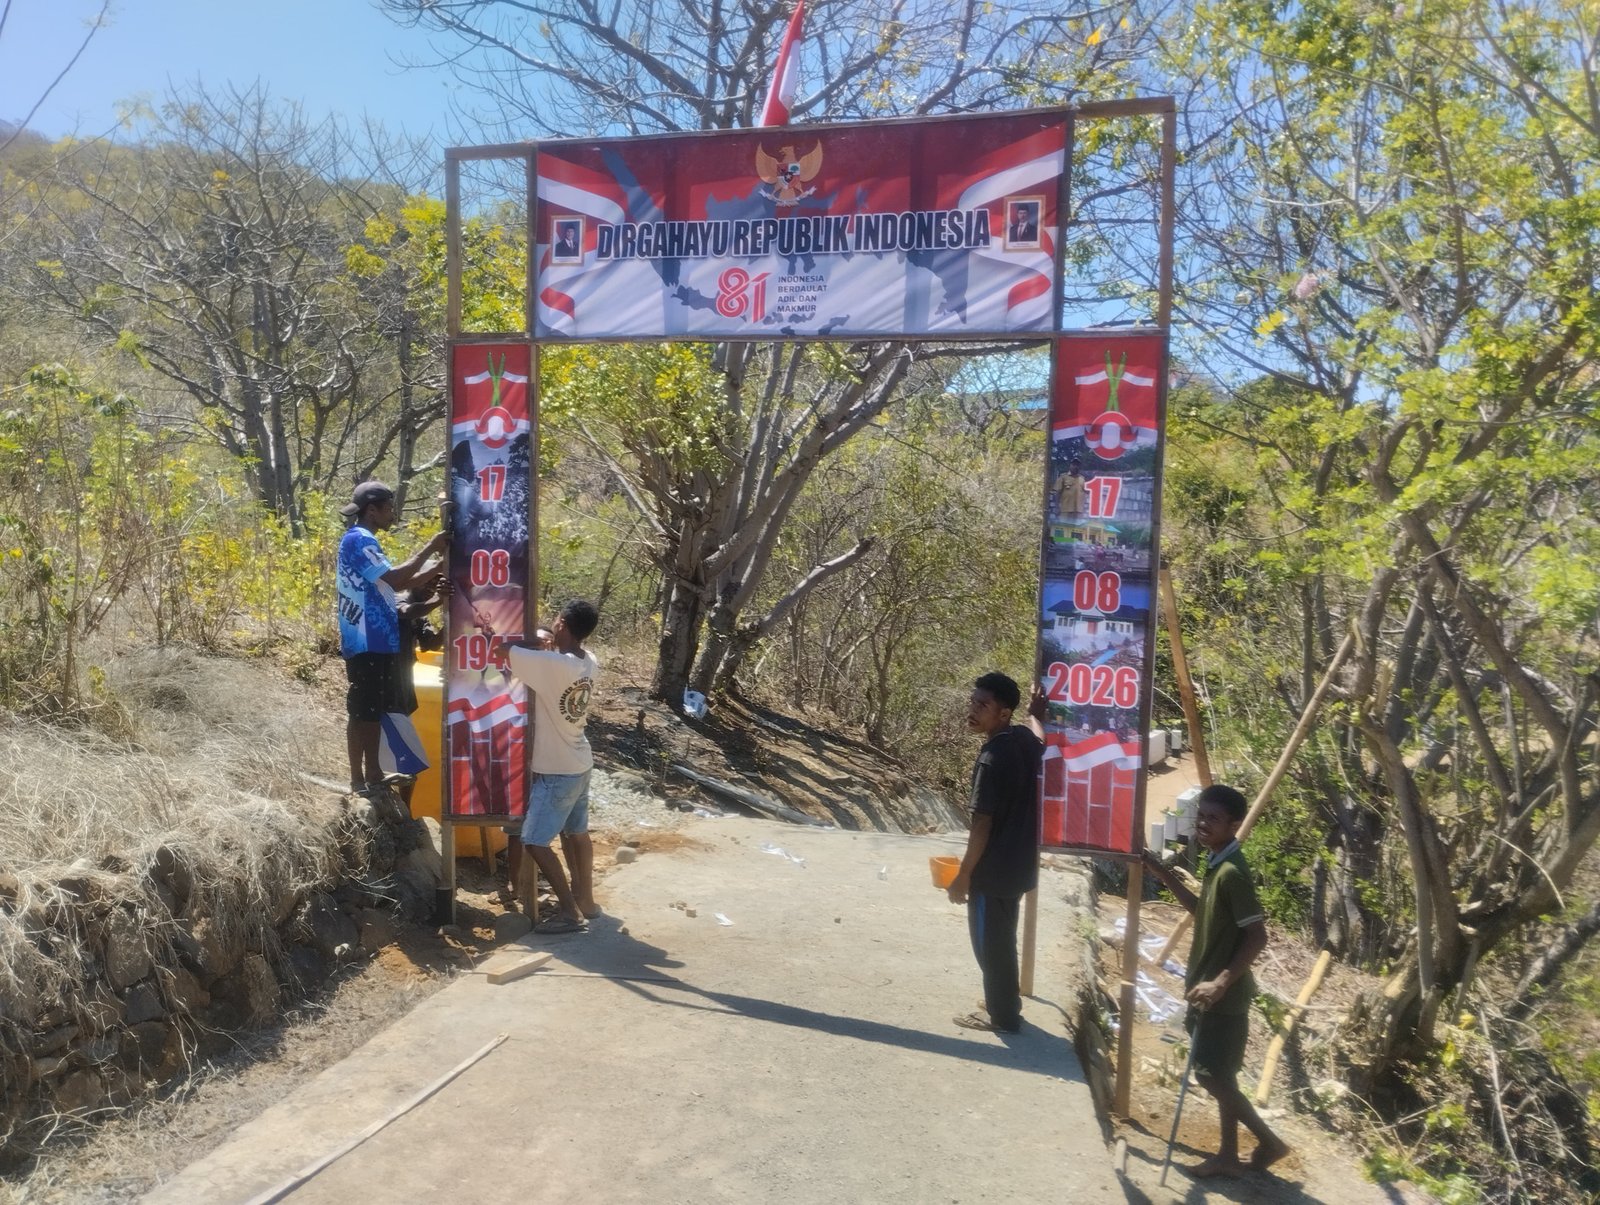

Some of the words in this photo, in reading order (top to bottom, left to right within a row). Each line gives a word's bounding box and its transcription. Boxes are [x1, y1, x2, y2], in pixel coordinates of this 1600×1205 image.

[597, 220, 731, 259] DIRGAHAYU
[733, 215, 850, 257] REPUBLIK
[853, 208, 991, 252] INDONESIA
[716, 267, 772, 324] 81
[778, 275, 824, 283] INDONESIA
[778, 285, 827, 293] BERDAULAT
[778, 295, 796, 303] ADIL
[799, 295, 817, 303] DAN
[478, 465, 507, 502] 17
[1085, 476, 1122, 518] 17
[471, 549, 510, 587] 08
[1074, 570, 1121, 613] 08
[1047, 661, 1139, 709] 2026
